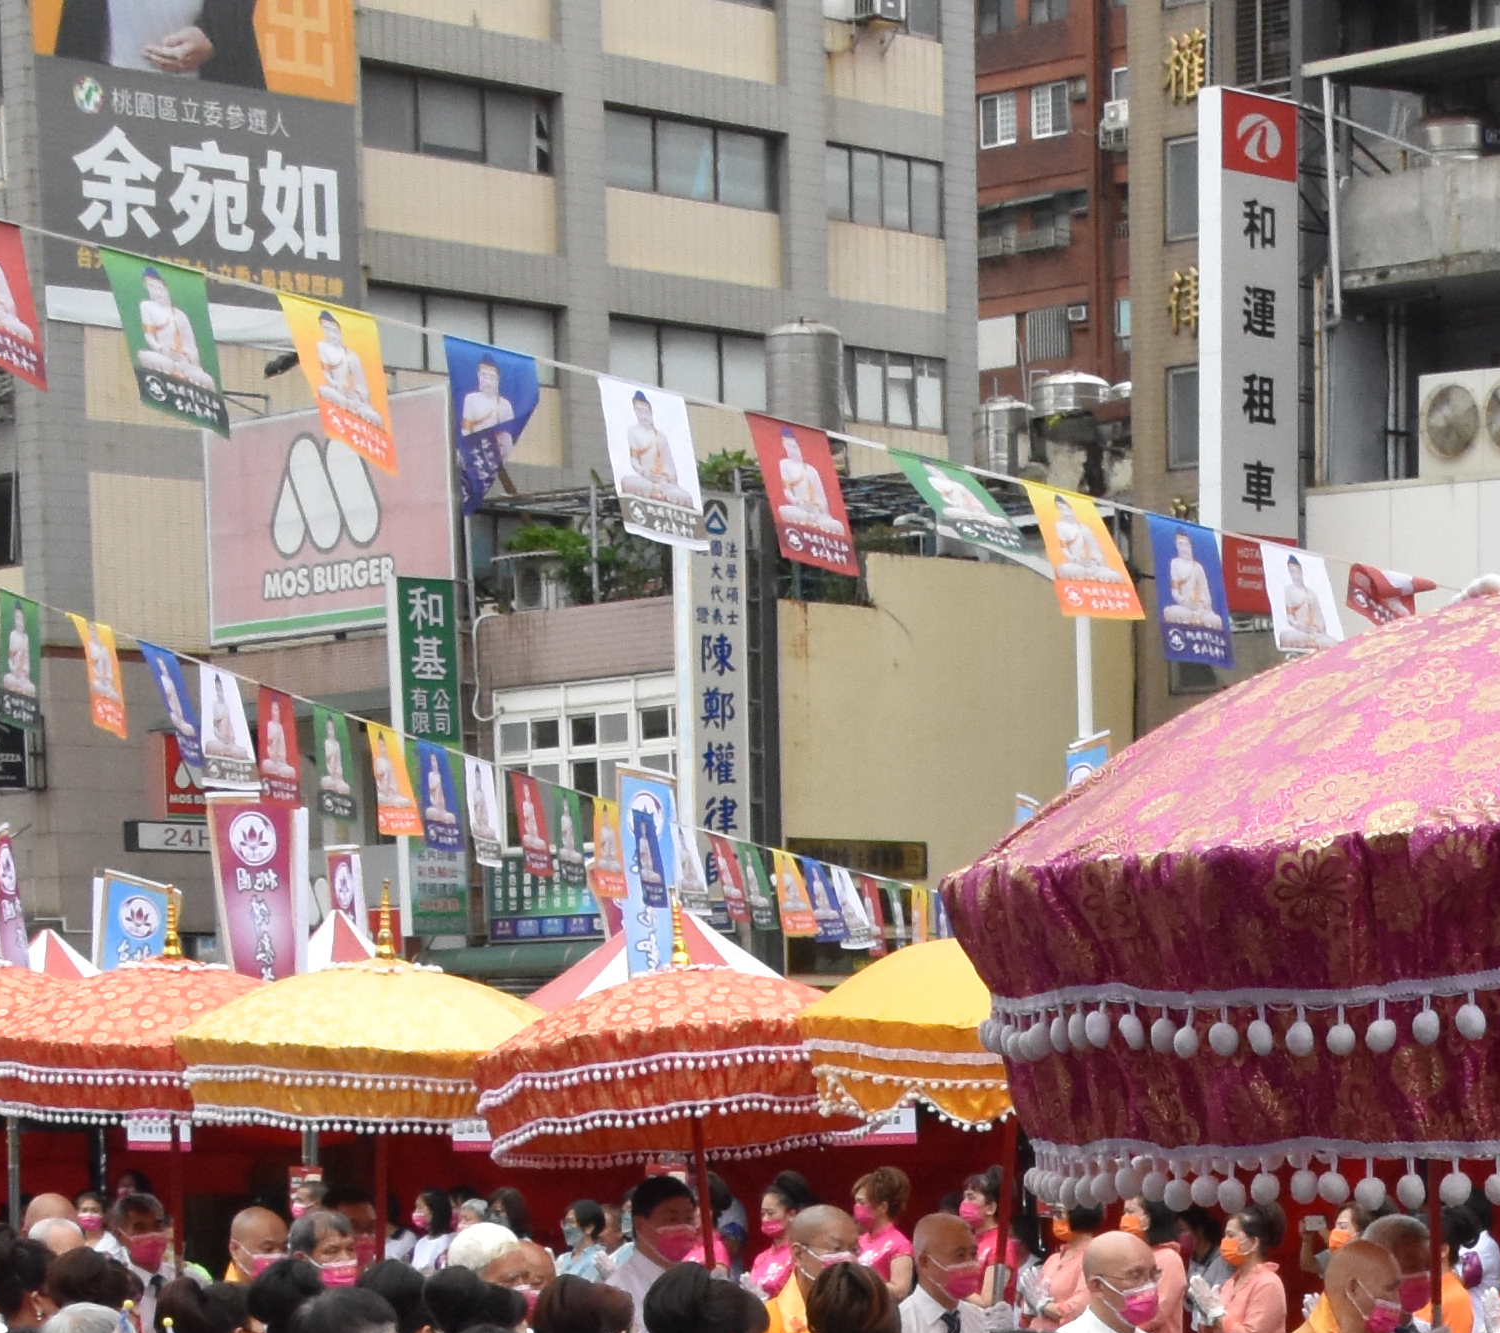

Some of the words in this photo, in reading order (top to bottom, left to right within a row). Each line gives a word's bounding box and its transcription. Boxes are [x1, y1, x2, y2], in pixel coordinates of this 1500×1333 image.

[111, 87, 291, 138] 桃園區立委參選人
[71, 125, 342, 262] 余宛如
[1241, 198, 1277, 513] 和運租車
[263, 566, 311, 600] MOS
[311, 554, 395, 595] BURGER
[407, 586, 448, 681] 和基
